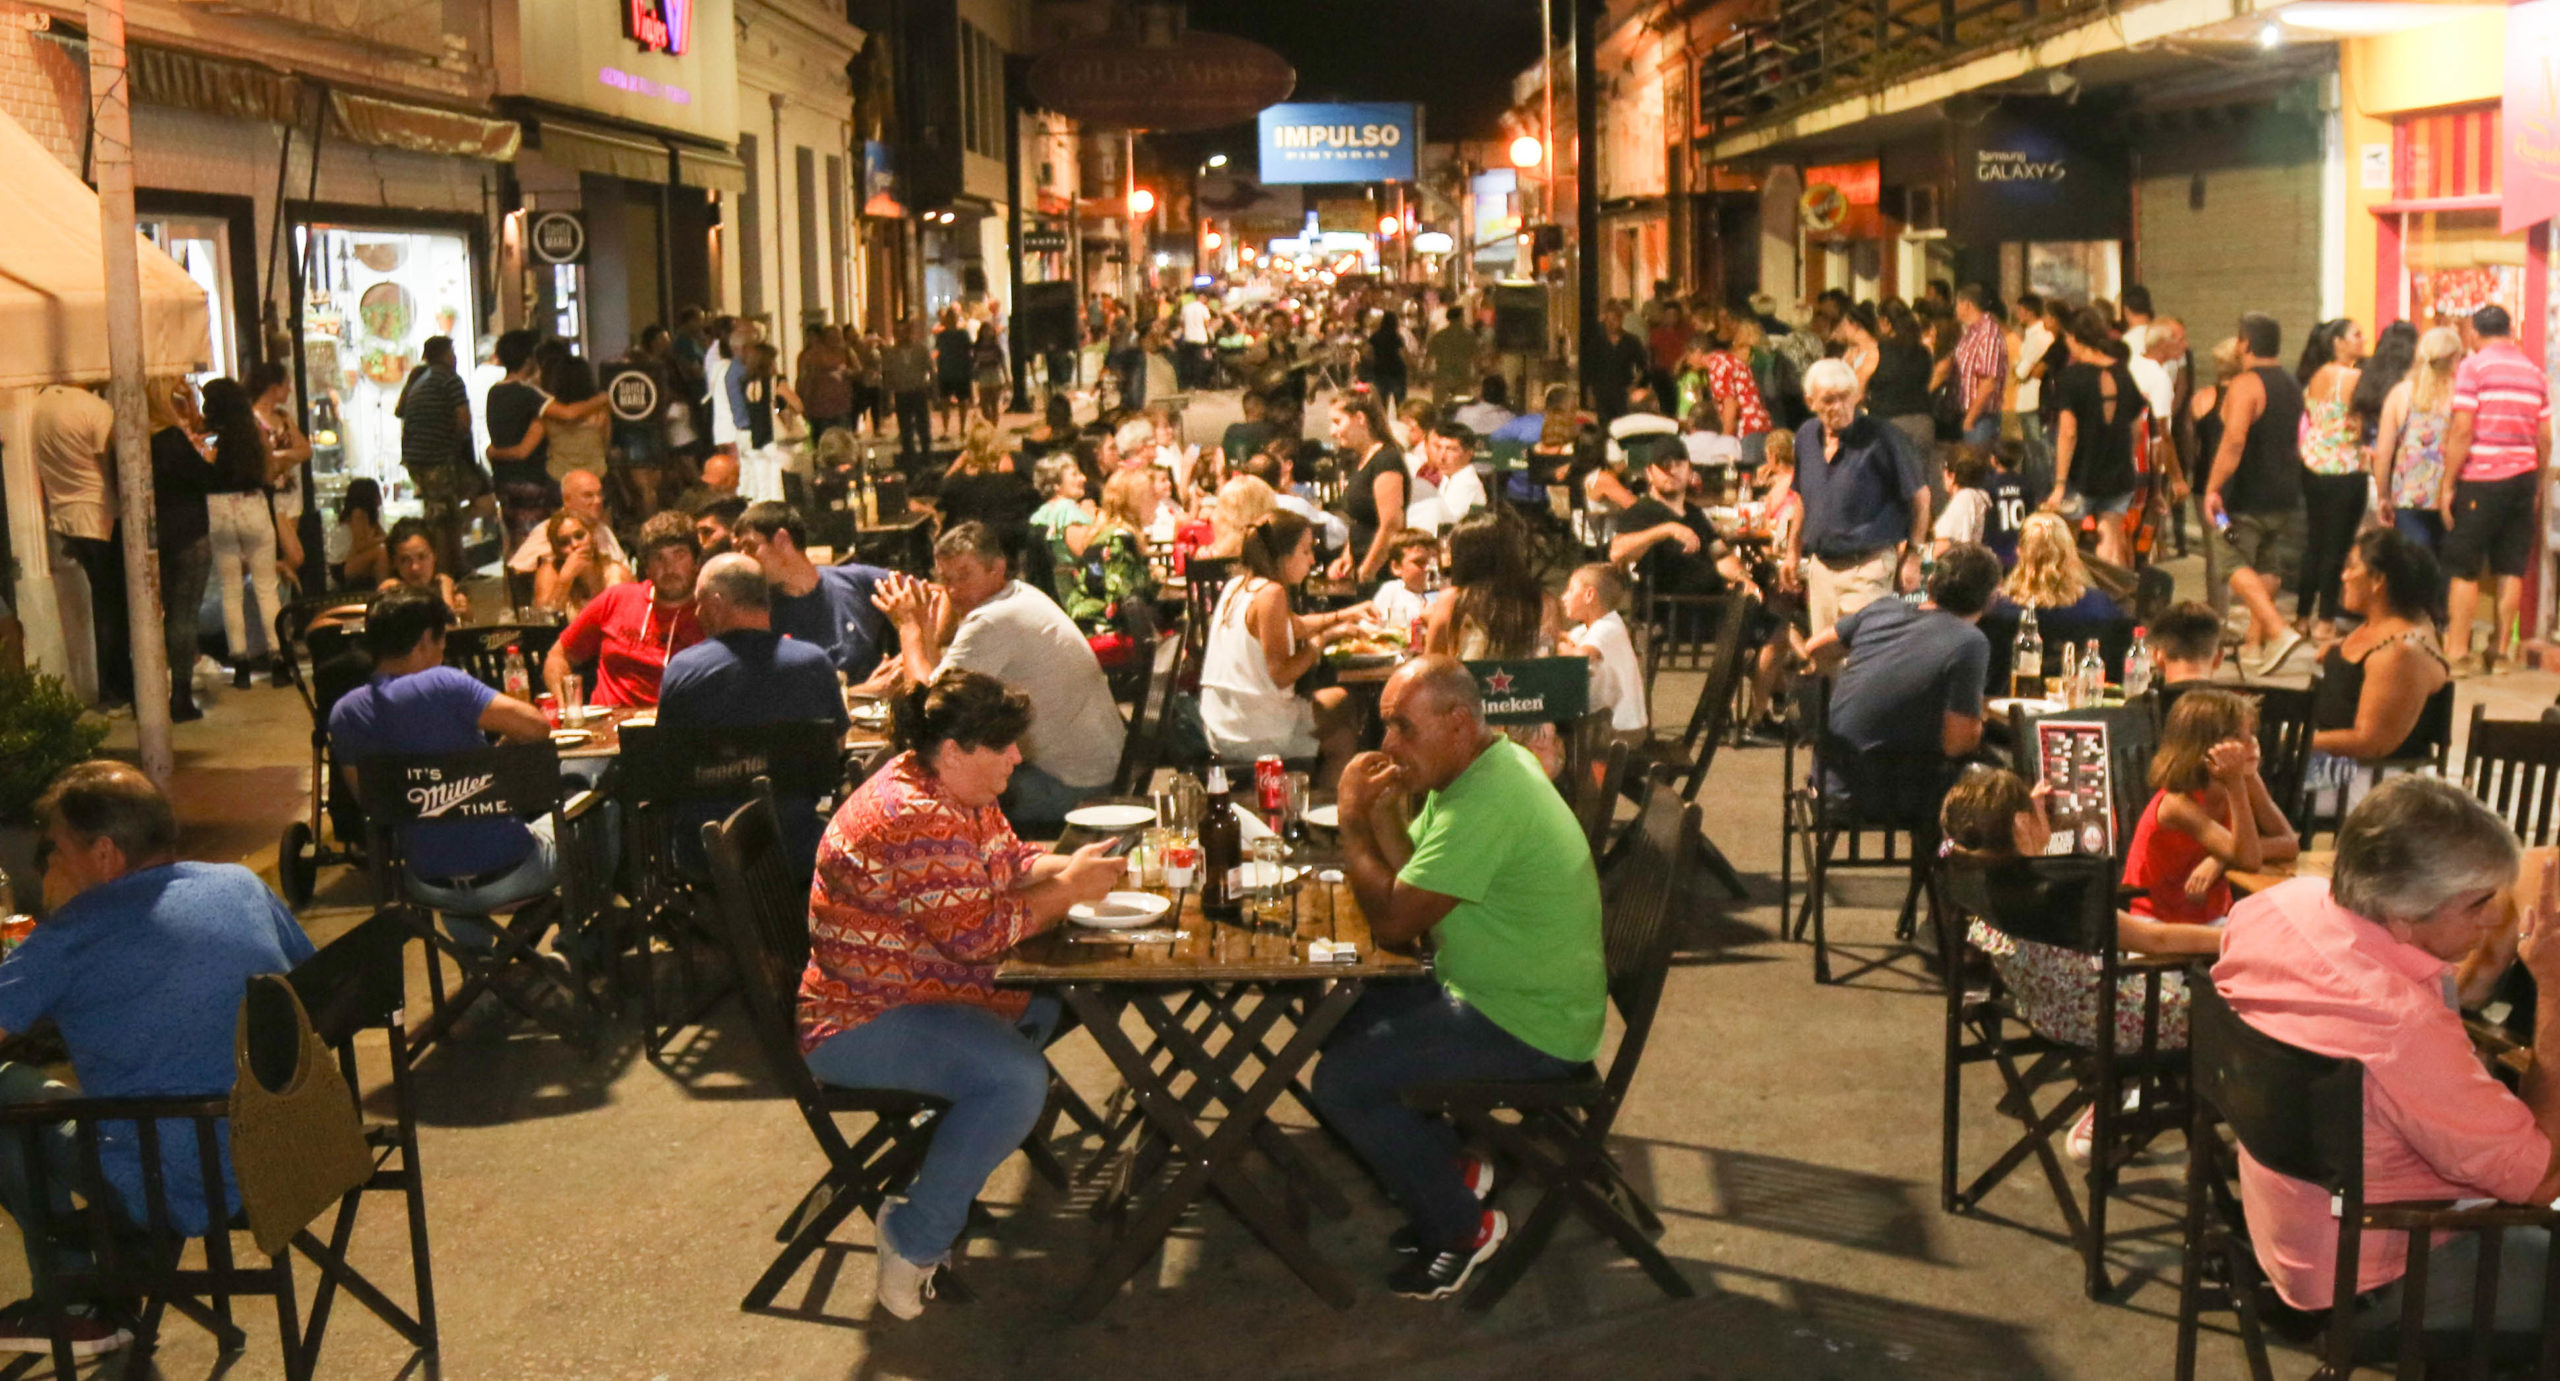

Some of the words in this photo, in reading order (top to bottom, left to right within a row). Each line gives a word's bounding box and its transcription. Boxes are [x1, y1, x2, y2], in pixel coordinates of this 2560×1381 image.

[1274, 124, 1400, 148] IMPULSO
[1979, 150, 2027, 163] Samsung
[1979, 163, 2047, 181] GALAXY
[1998, 499, 2026, 532] 10
[1481, 696, 1545, 715] ineken
[407, 768, 442, 780] IT'S
[407, 773, 494, 818] Miller
[459, 800, 513, 815] TIME.
